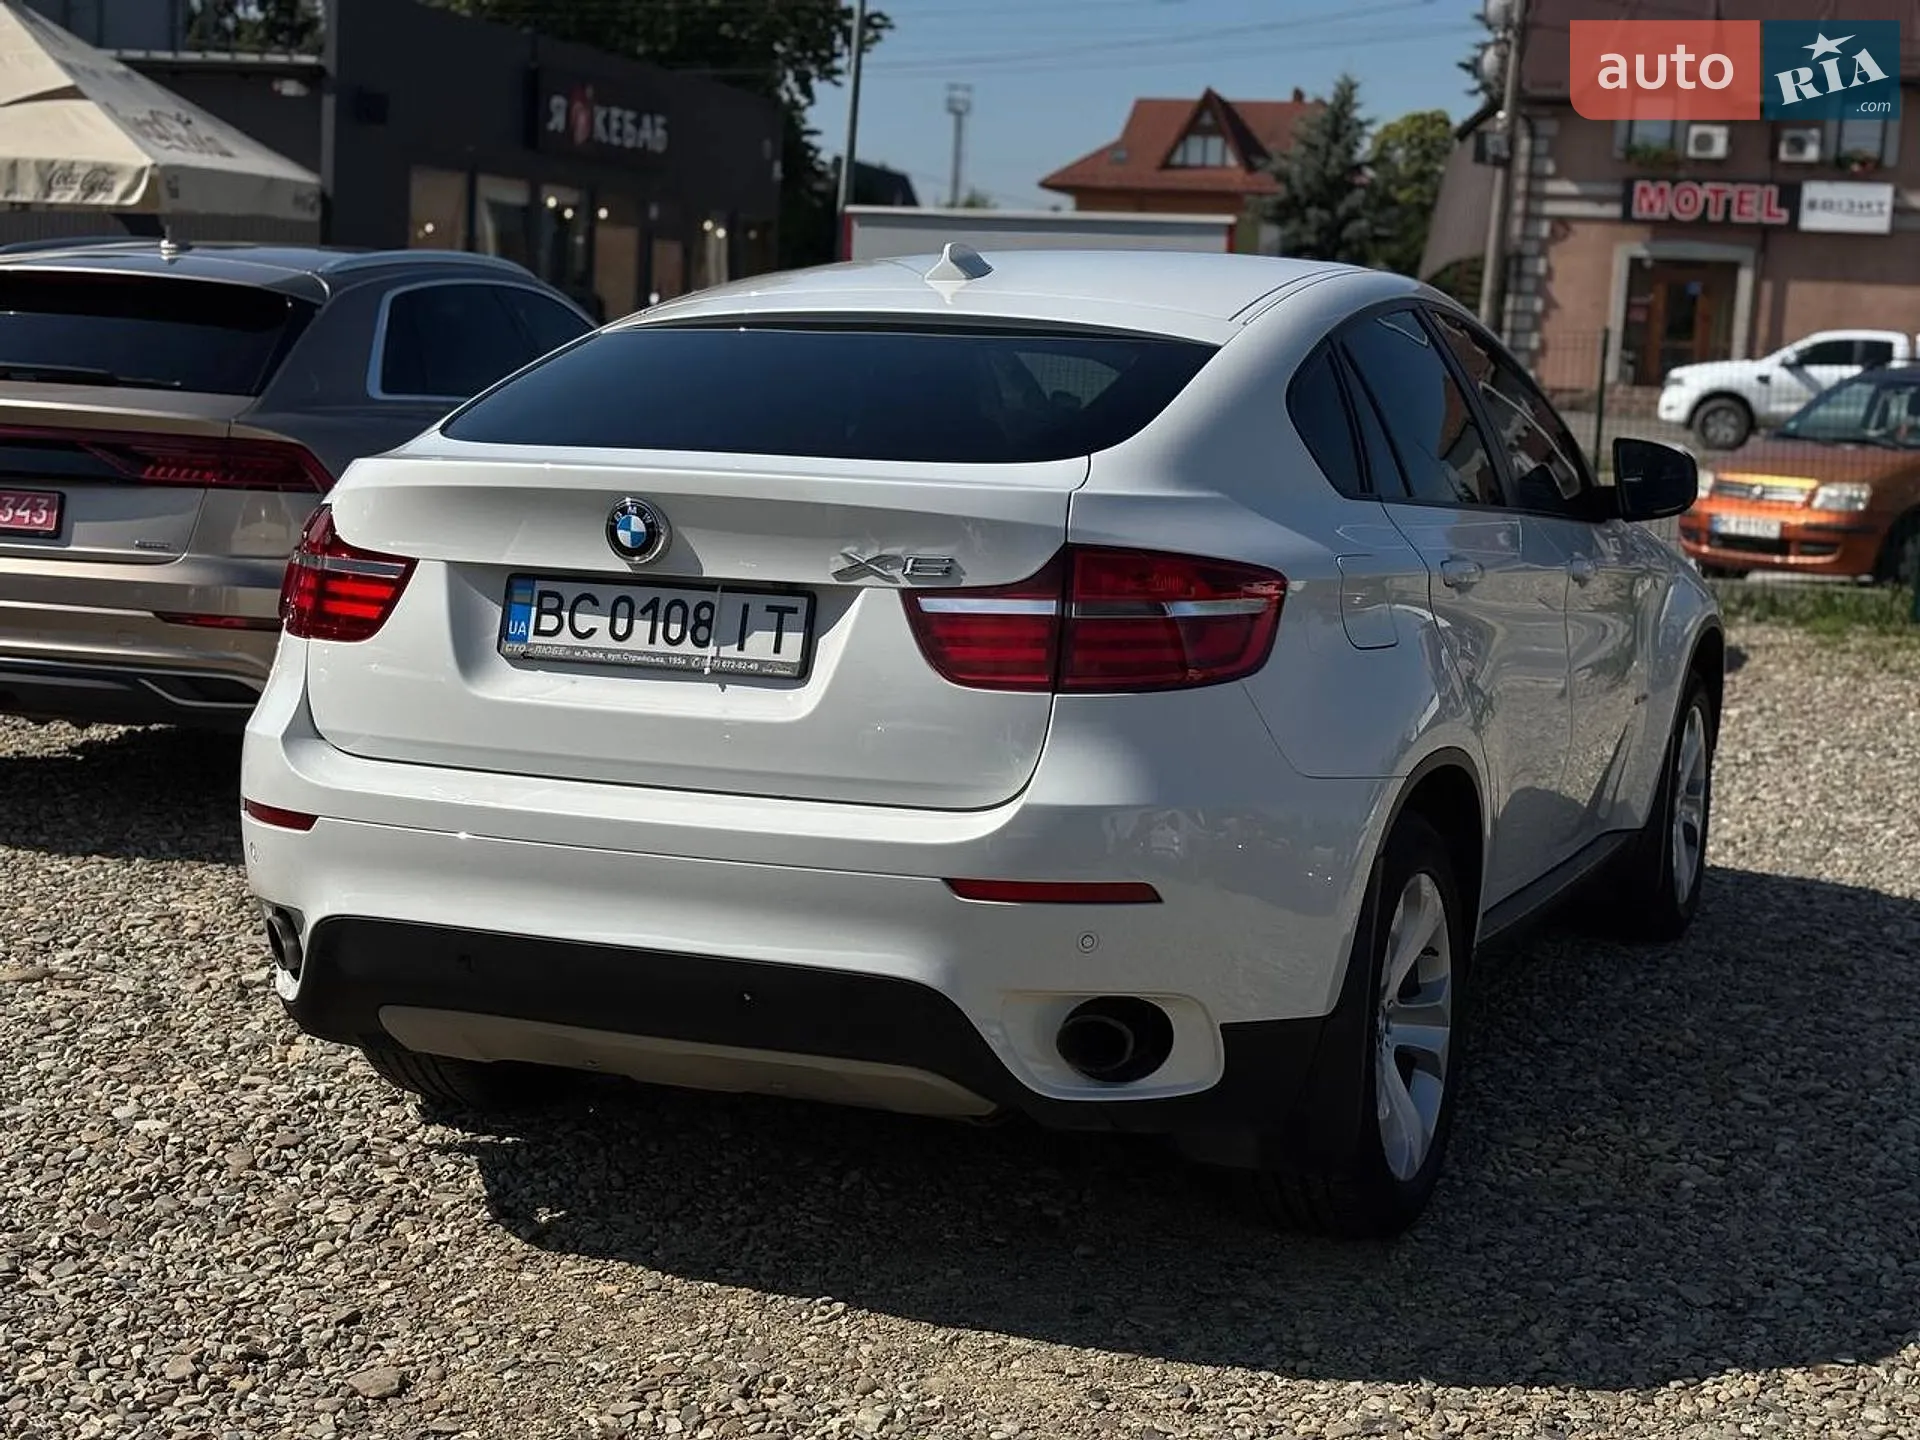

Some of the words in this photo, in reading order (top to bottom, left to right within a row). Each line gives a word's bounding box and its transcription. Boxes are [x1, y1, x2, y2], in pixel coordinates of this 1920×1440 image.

[546, 94, 568, 133] Я
[593, 104, 669, 154] КЕБАБ
[1632, 180, 1789, 225] MOTEL
[509, 620, 527, 636] UA
[533, 590, 600, 640] BC
[608, 594, 716, 649] 0108
